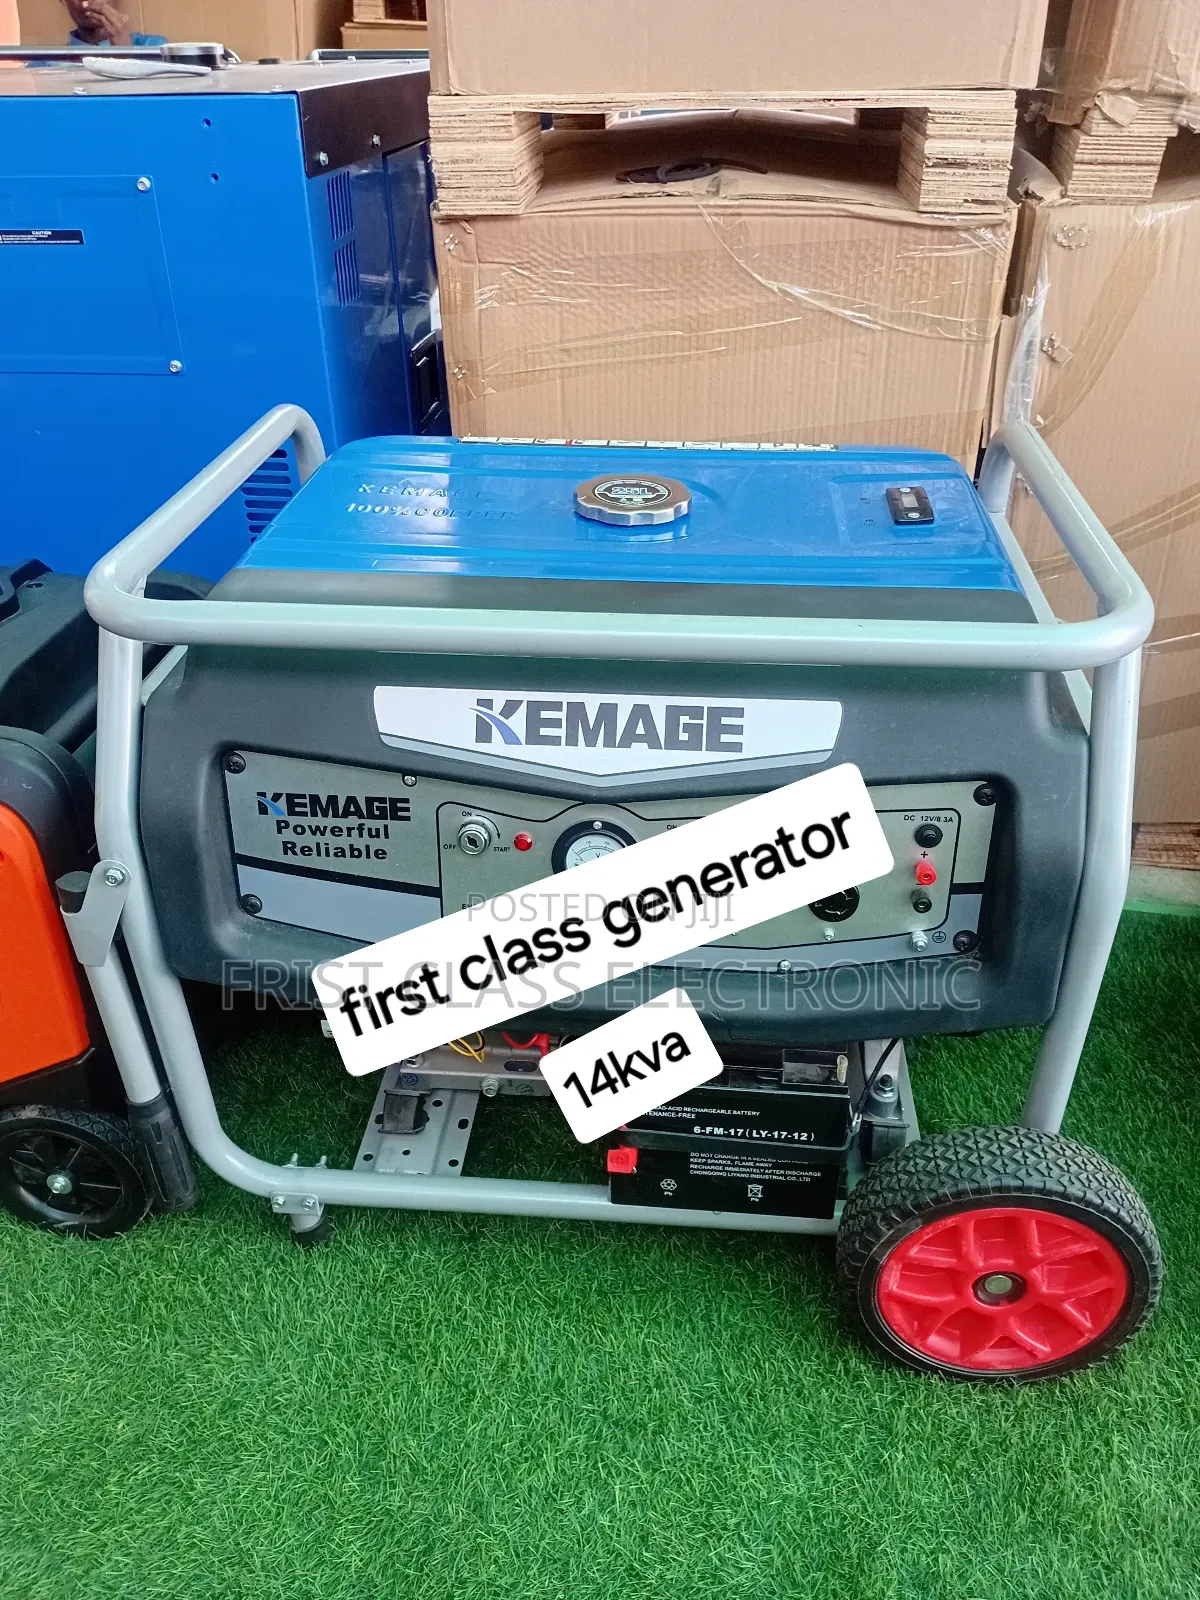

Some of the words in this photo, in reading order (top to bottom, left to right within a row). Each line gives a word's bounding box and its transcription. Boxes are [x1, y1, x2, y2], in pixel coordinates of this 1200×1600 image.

[358, 483, 494, 502] KEMAGE
[468, 698, 744, 753] KEMAGE
[253, 791, 411, 821] KEMAGE
[920, 815, 954, 823] 12V/8.3A
[275, 819, 390, 840] Powerful
[281, 840, 388, 860] Reliable
[683, 1106, 732, 1115] RECHARGEABLE
[732, 1109, 761, 1117] BATTERY
[690, 1163, 724, 1171] RECHARGE
